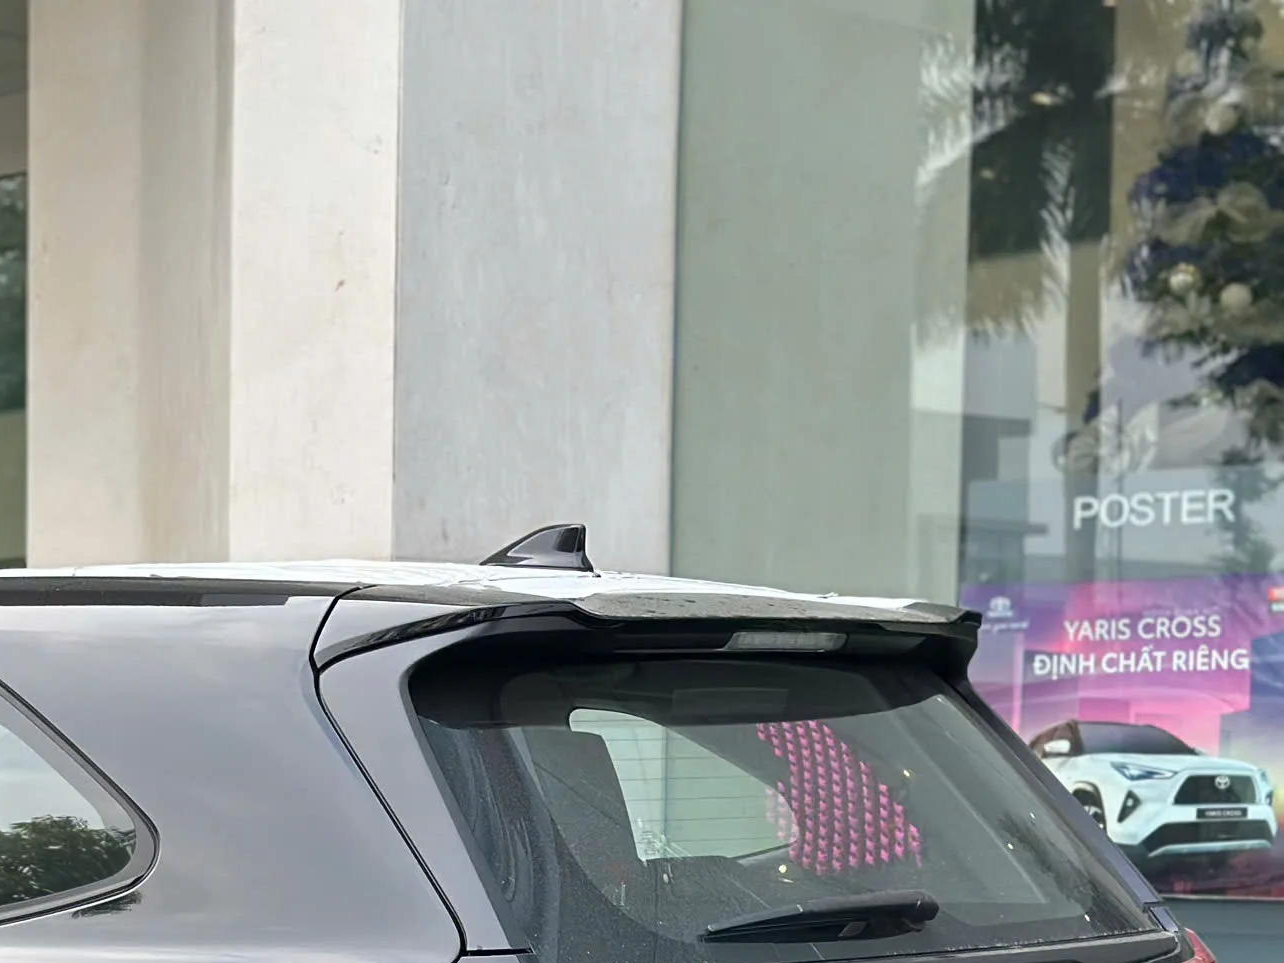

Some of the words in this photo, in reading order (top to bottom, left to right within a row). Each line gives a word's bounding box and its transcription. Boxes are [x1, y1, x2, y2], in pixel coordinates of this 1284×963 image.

[1073, 489, 1235, 529] POSTER
[1063, 617, 1131, 642] YARIS
[1137, 614, 1222, 640] CROSS
[1032, 652, 1095, 681] ĐỊNH
[1101, 644, 1166, 673] CHẤT
[1172, 644, 1250, 672] RIÊNG
